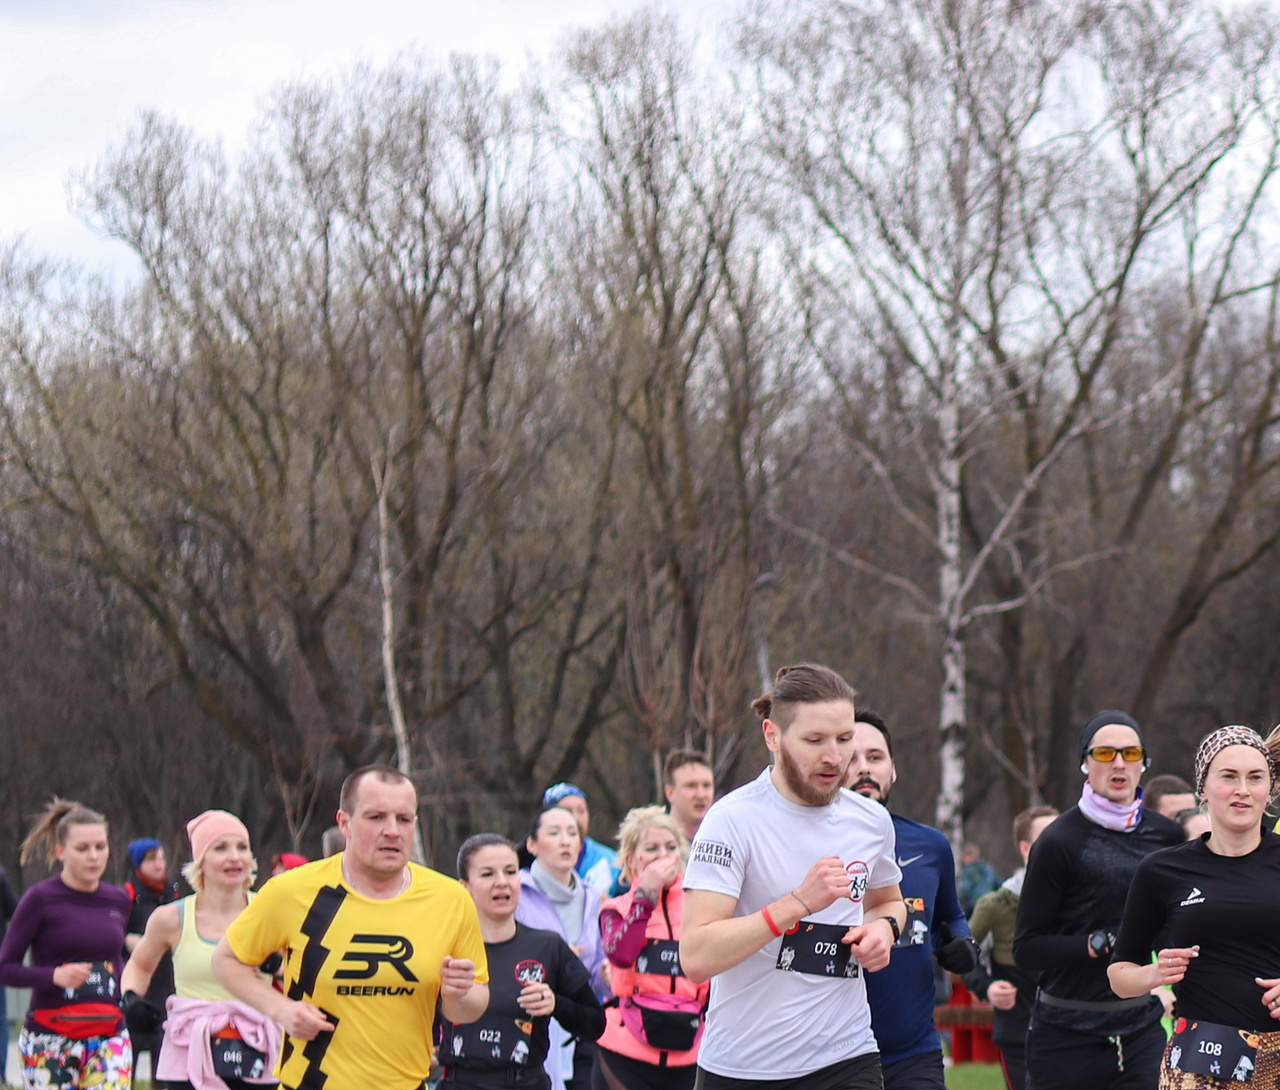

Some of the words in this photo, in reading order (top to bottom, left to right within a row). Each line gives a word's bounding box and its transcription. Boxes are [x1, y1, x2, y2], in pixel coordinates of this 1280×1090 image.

[660, 949, 679, 964] 071
[814, 941, 838, 957] 078
[336, 985, 415, 996] BEERUN
[479, 1028, 502, 1043] 022
[1198, 1040, 1223, 1056] 108
